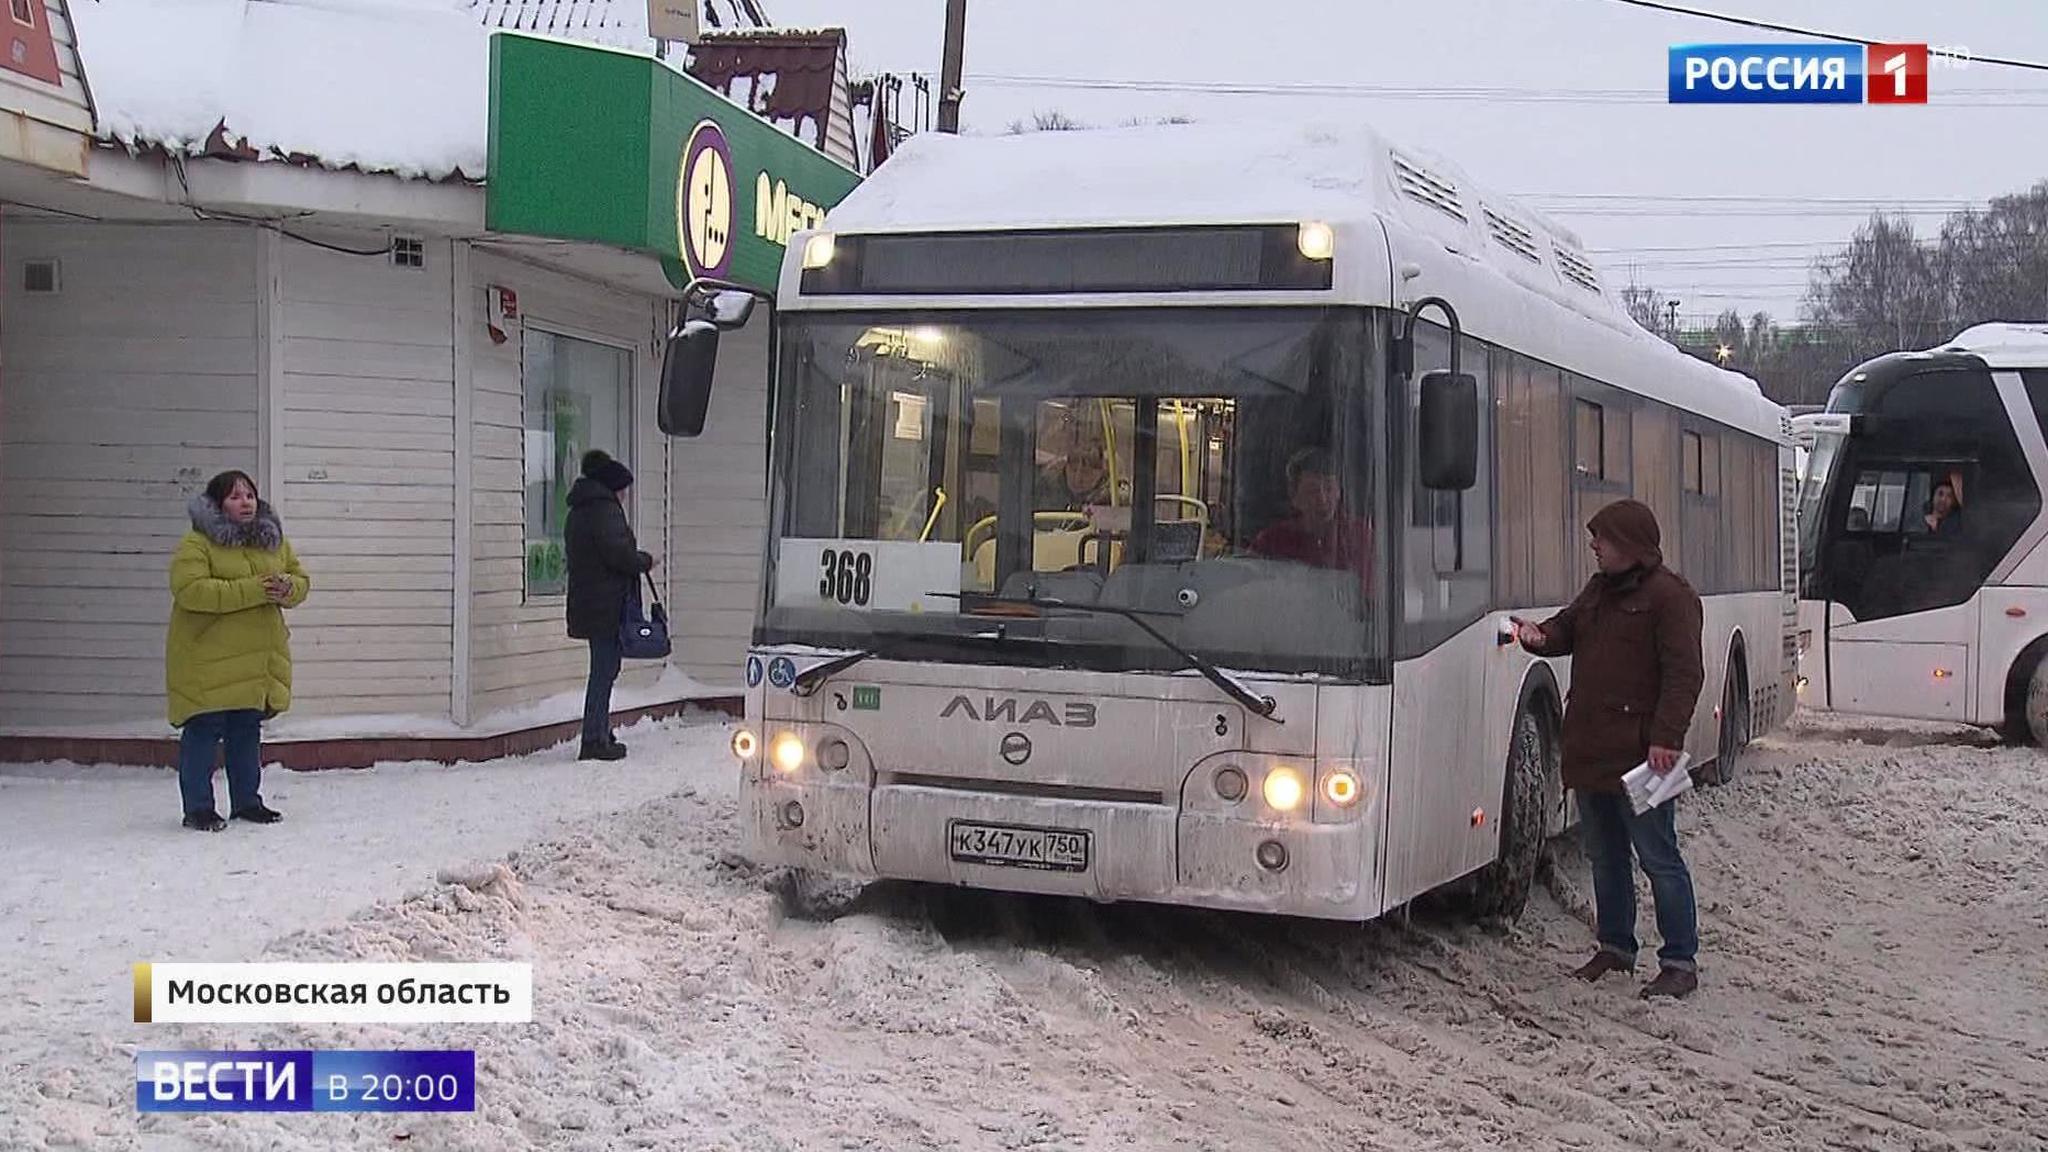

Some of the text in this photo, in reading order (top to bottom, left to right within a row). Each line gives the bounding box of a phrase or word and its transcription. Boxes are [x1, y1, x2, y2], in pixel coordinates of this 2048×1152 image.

[820, 548, 872, 606] 368
[939, 695, 1097, 728] ЛИАЗ
[959, 829, 1080, 859] К347УК 750
